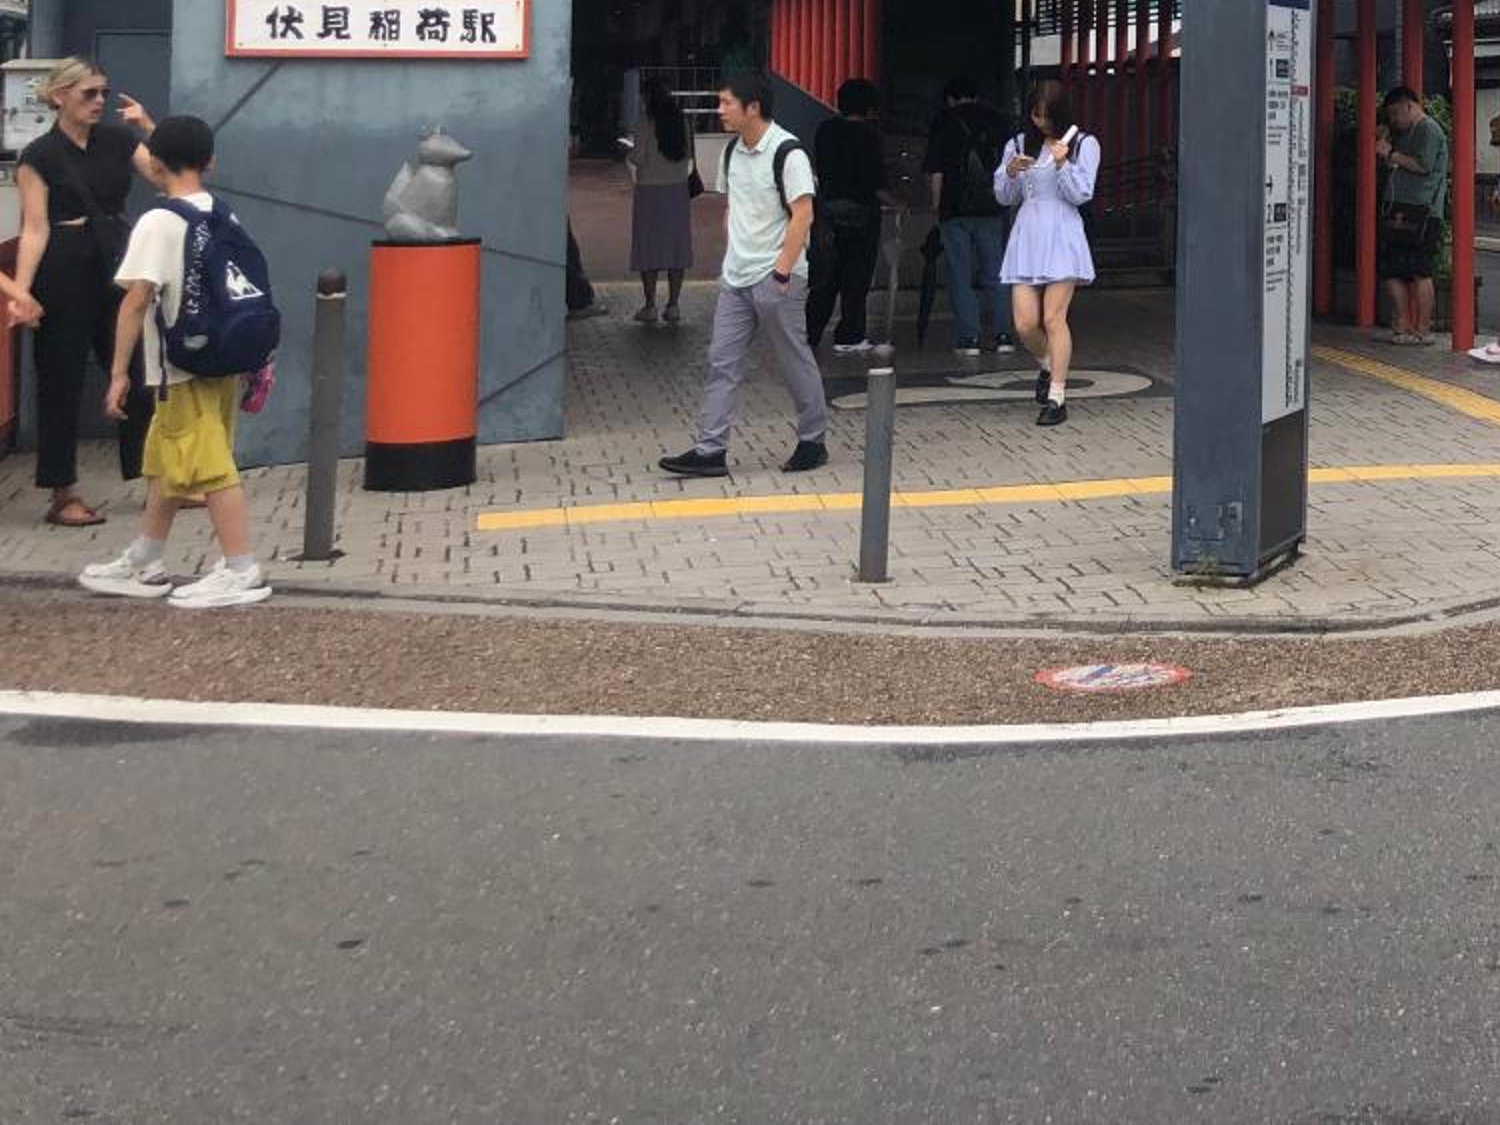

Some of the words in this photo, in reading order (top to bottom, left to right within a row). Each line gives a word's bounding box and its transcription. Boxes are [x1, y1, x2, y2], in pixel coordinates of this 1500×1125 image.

[264, 4, 497, 44] 伏見稲荷駅
